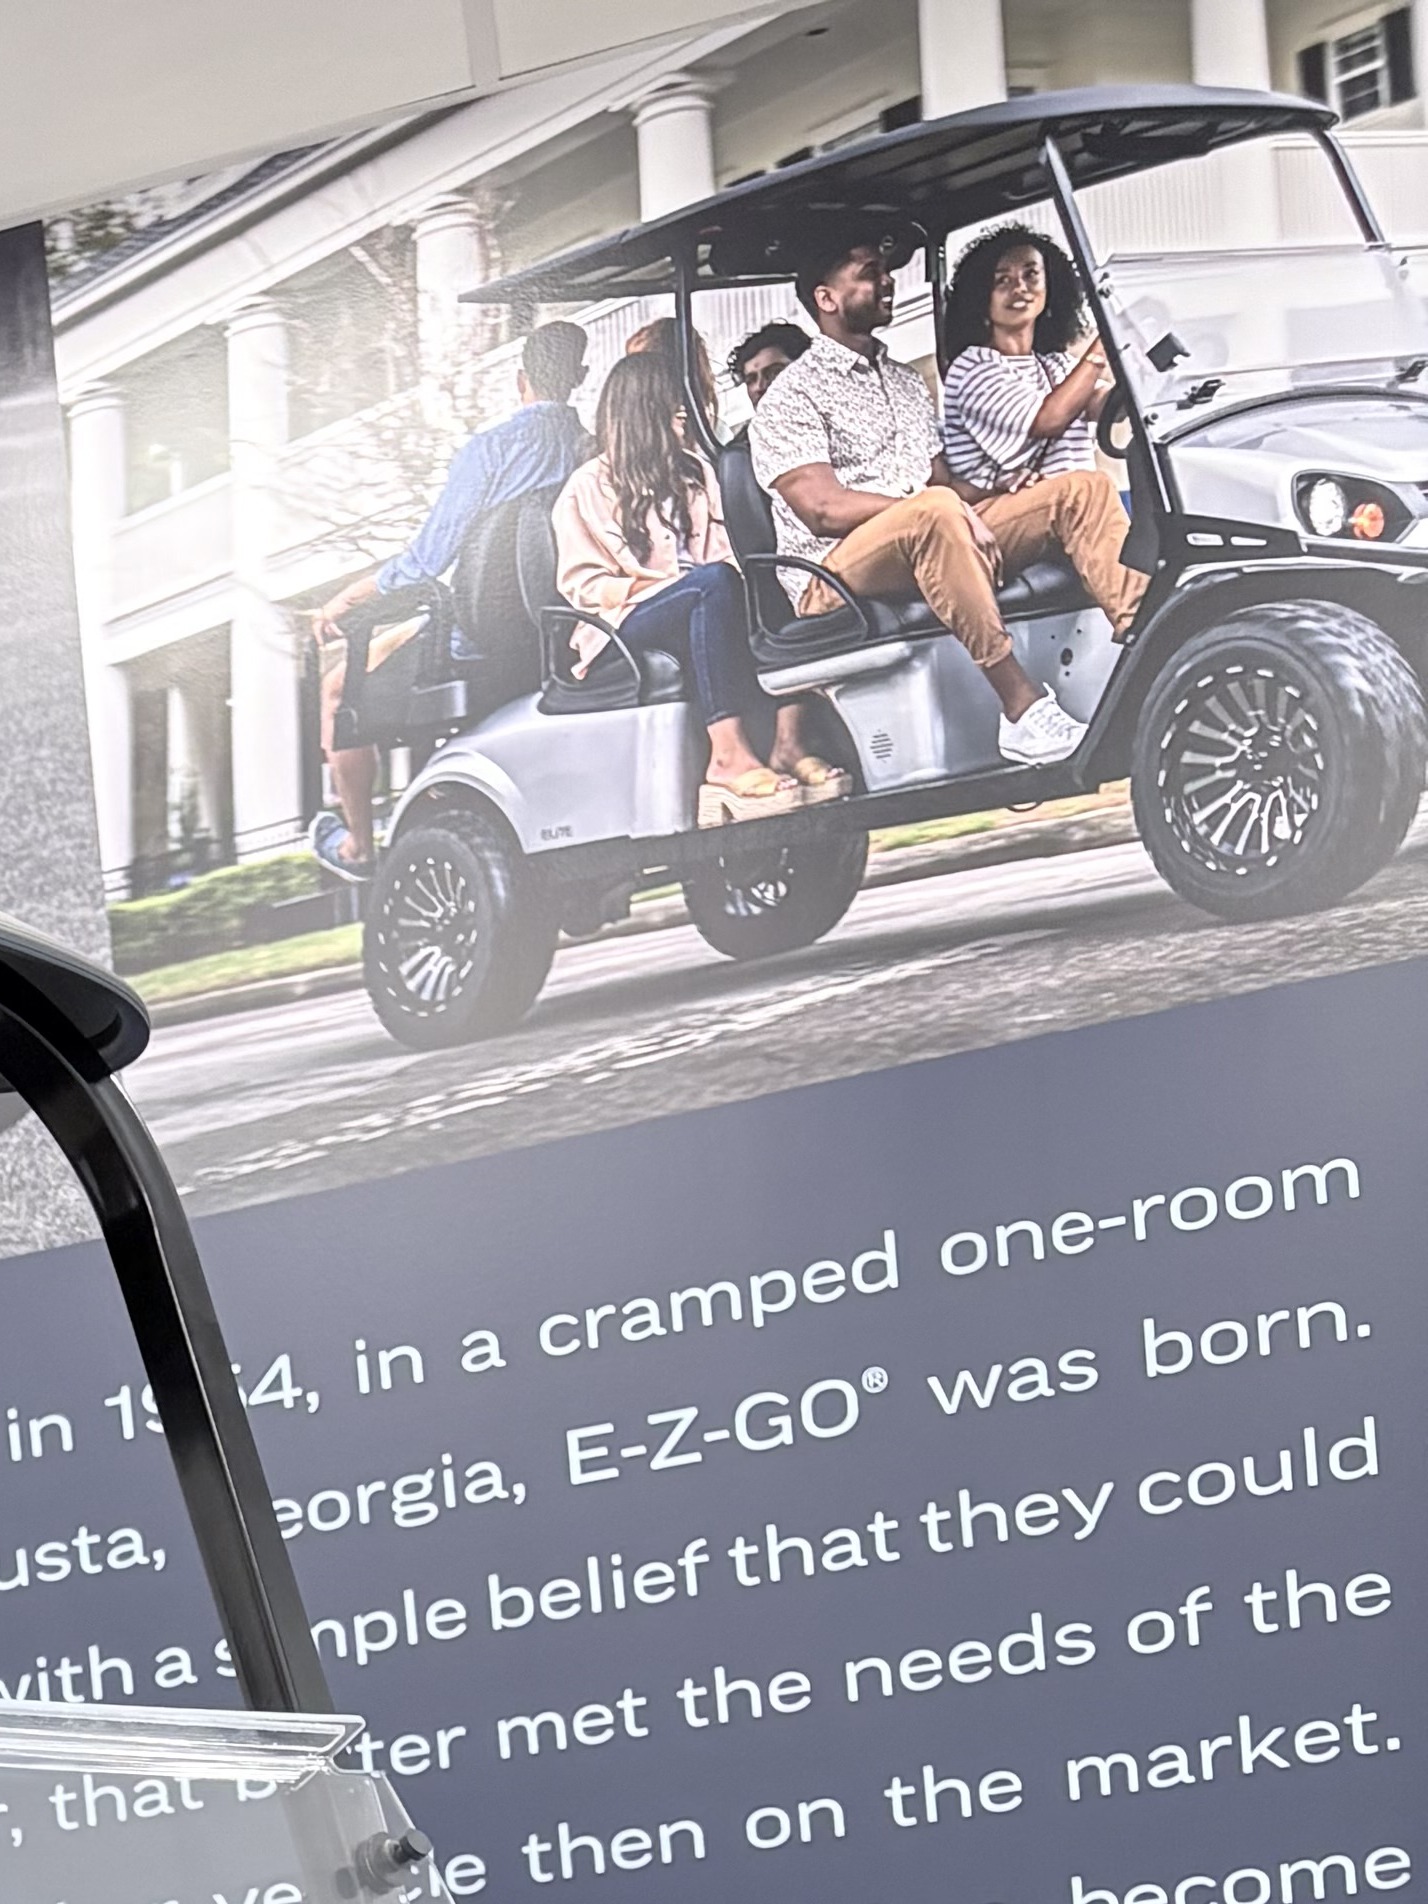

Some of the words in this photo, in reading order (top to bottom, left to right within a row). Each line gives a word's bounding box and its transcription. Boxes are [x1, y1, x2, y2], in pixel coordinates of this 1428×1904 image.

[7, 1408, 73, 1461] in
[356, 1339, 423, 1393] in
[462, 1331, 506, 1372] a
[540, 1230, 898, 1355] cramped
[941, 1159, 1359, 1275] one-room
[274, 1451, 527, 1544] eorgia,
[927, 1350, 1098, 1414] was
[1144, 1302, 1370, 1377] born.
[155, 1647, 198, 1687] a
[214, 1587, 468, 1680] smple
[488, 1538, 709, 1630] belief
[728, 1512, 900, 1586] that
[920, 1482, 1114, 1552] they
[1139, 1416, 1378, 1514] could
[49, 1773, 204, 1829] that
[498, 1688, 648, 1759] met
[676, 1666, 811, 1727] the
[846, 1613, 1095, 1702] needs
[1128, 1586, 1212, 1653] of
[1244, 1569, 1391, 1633] the
[522, 1820, 705, 1882] then
[746, 1799, 845, 1848] on
[884, 1765, 1022, 1826] the
[1067, 1704, 1400, 1800] market.
